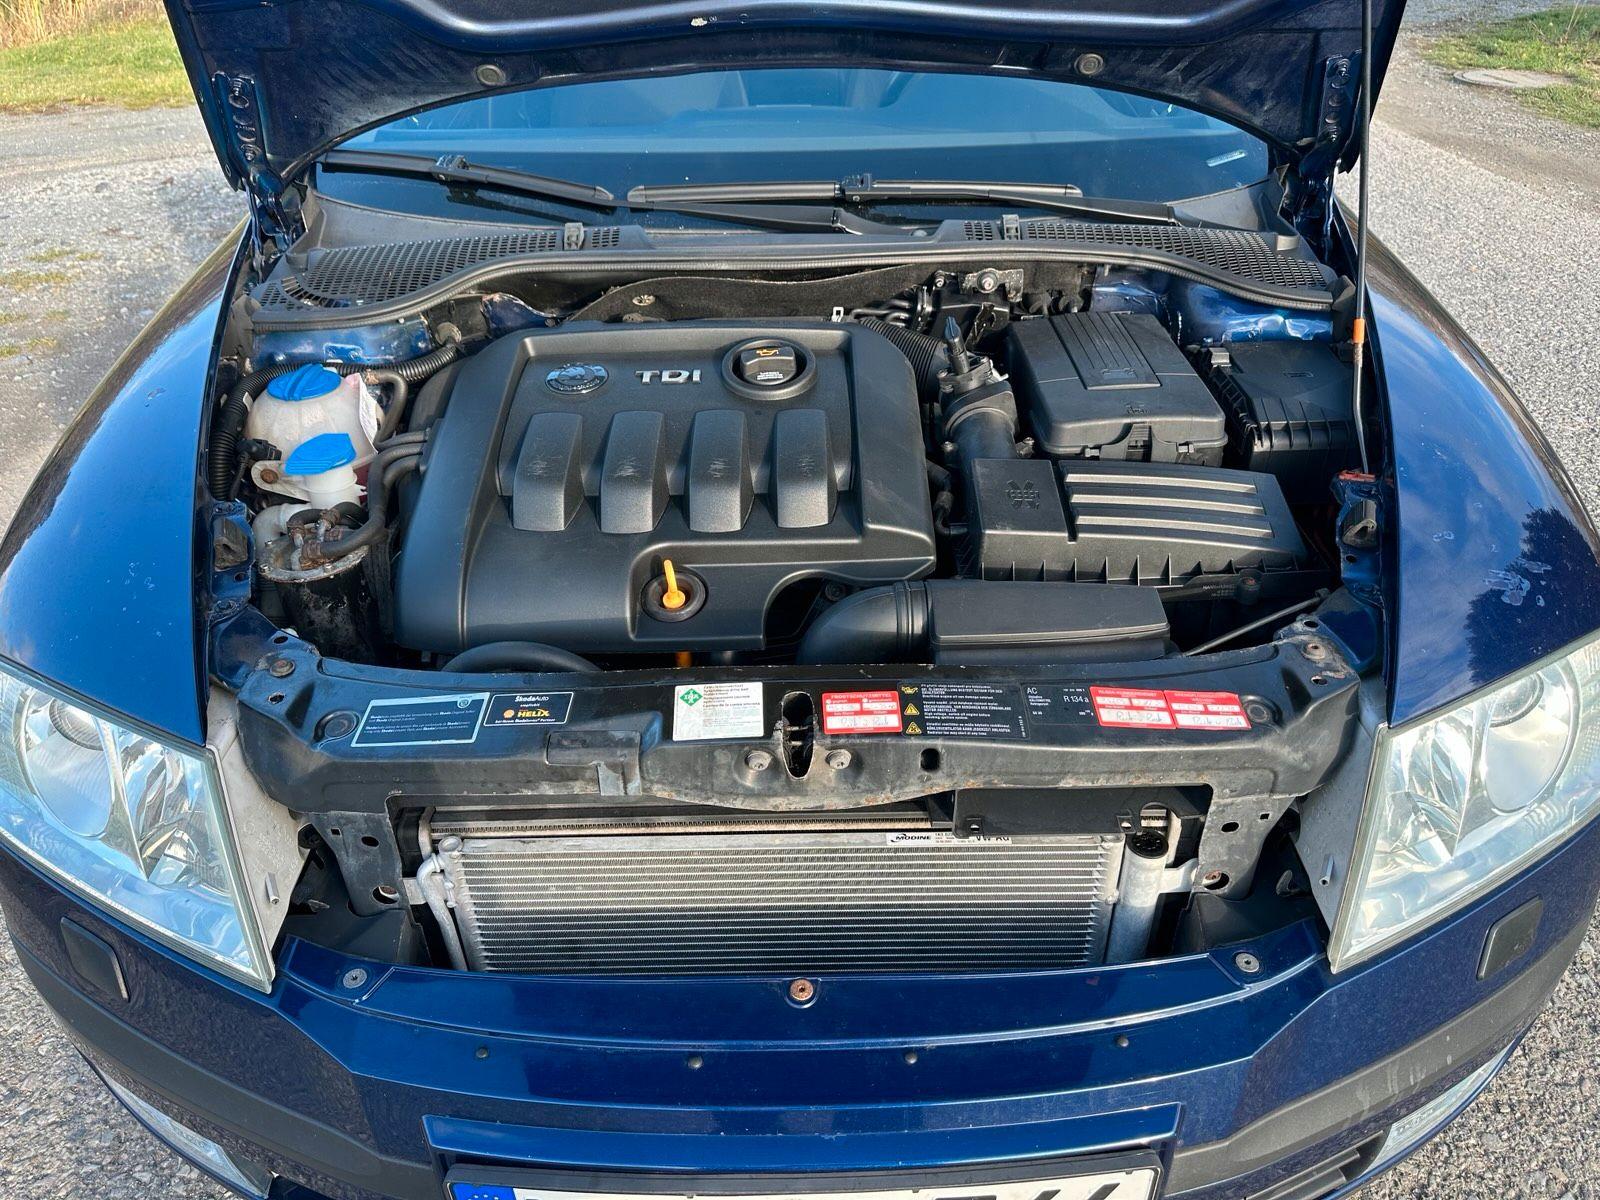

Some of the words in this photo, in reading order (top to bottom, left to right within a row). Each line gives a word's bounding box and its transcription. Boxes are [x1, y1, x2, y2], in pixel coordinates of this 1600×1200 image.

[635, 369, 701, 384] TDI
[1026, 687, 1038, 695] AC
[1063, 695, 1070, 703] R
[1071, 695, 1084, 703] 134
[517, 709, 550, 718] HELIX
[895, 833, 930, 841] MODINE
